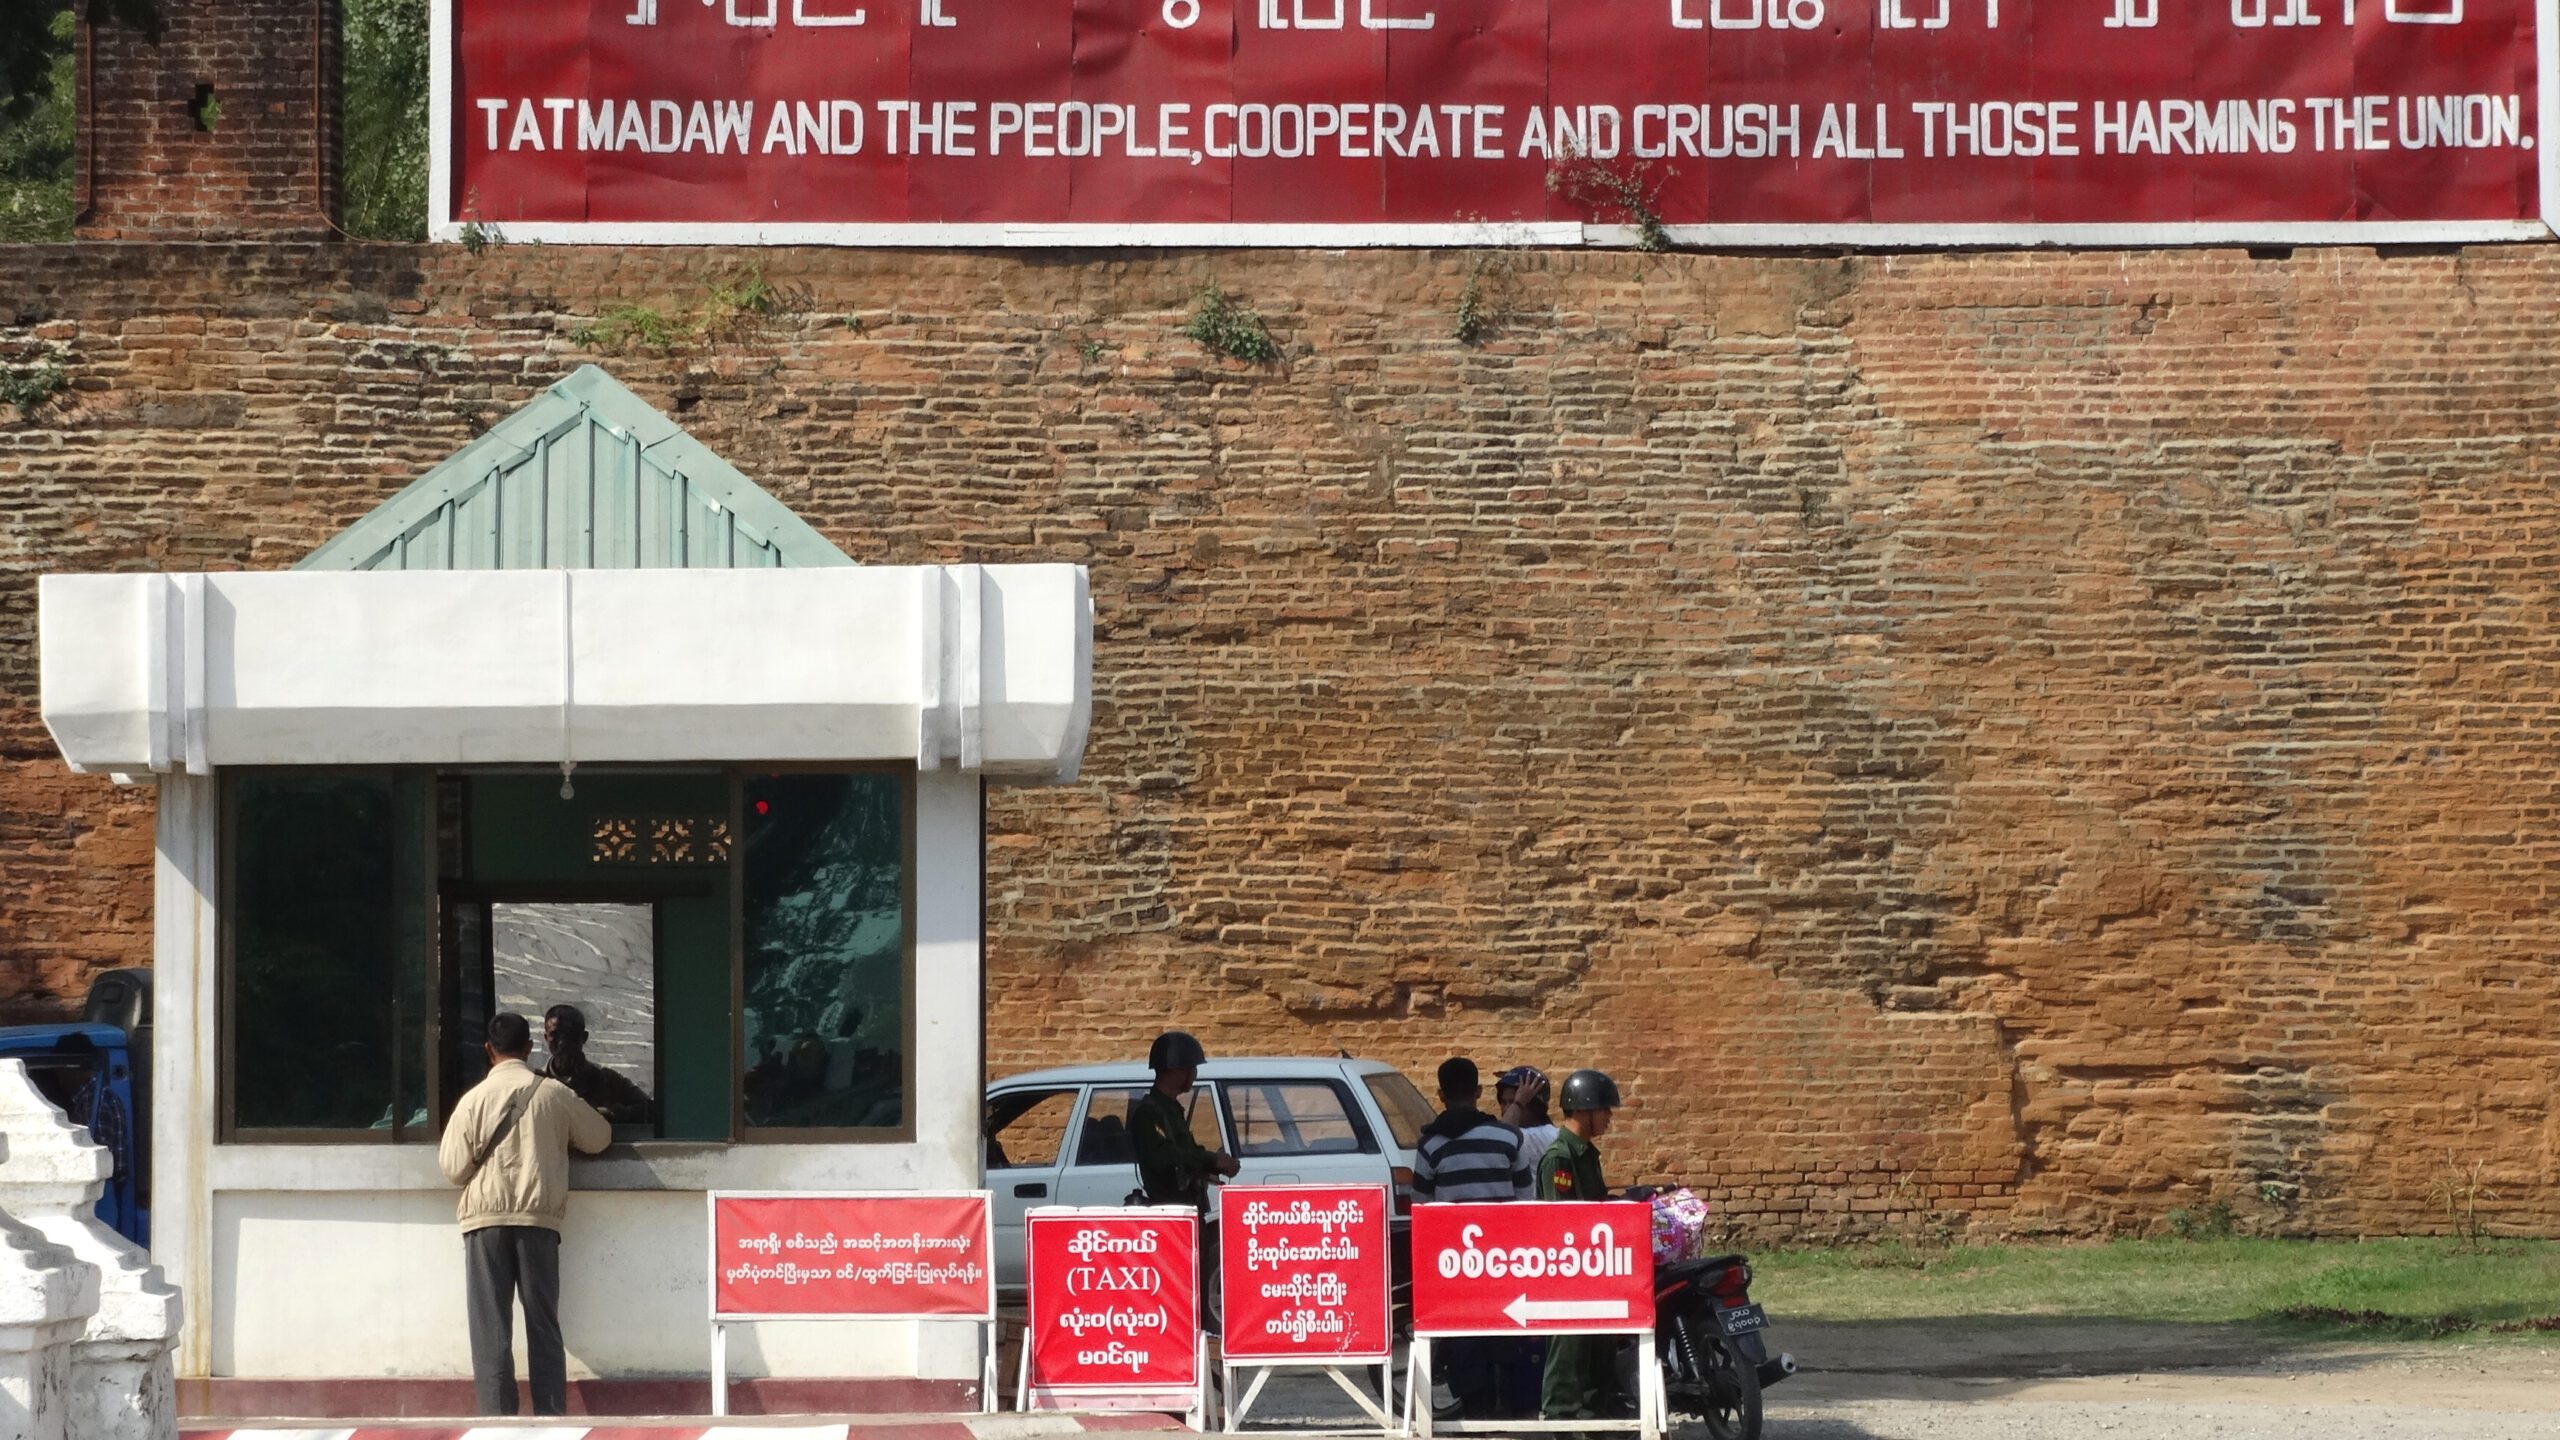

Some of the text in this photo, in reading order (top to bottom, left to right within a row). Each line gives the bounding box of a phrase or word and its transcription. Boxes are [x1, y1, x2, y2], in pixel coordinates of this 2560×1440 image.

[477, 98, 754, 155] TATMADAW
[762, 100, 865, 156] AND
[878, 101, 978, 157] THE
[1518, 104, 1622, 160] AND
[1633, 103, 1801, 158] CRUSH
[1813, 102, 1906, 160] ALL
[1912, 101, 2081, 157] THOSE
[2094, 98, 2298, 156] HARMING
[2305, 96, 2392, 152] THE
[2398, 94, 2536, 152] UNION.
[1067, 1229, 1159, 1262] ဆိုင်ကယ်
[1438, 1222, 1633, 1279] စစ်ဆေးခံပါ။
[1066, 1266, 1162, 1297] (TAXI)
